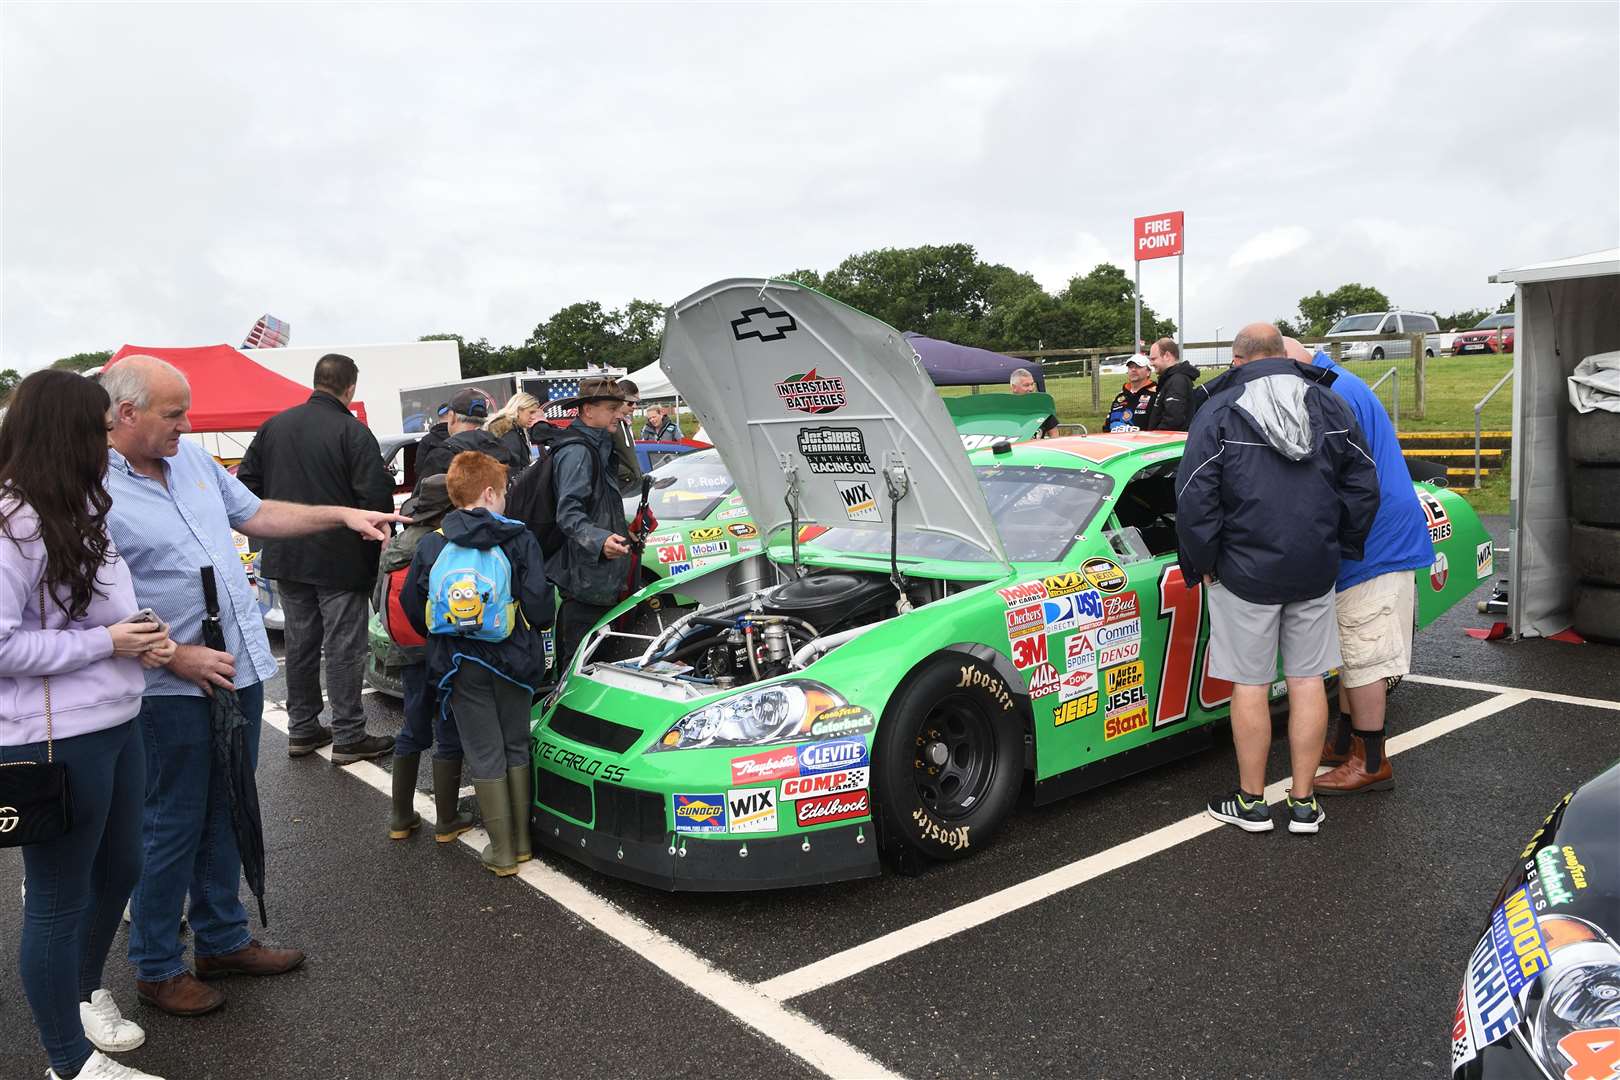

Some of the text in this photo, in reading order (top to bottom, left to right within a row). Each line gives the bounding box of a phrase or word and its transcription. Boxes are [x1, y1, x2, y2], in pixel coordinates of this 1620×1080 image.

[1144, 219, 1171, 234] FIRE
[1139, 233, 1176, 250] POINT
[777, 379, 843, 396] INTERSTATE
[786, 393, 846, 409] BATTERIES
[801, 443, 862, 452] PERFORMANCE
[807, 455, 870, 463] SYNTHETIC
[810, 462, 875, 474] RACING OIL
[841, 483, 872, 506] WIX
[658, 543, 687, 563] 3M
[692, 543, 717, 554] Mobil
[1477, 542, 1492, 567] WIX
[999, 581, 1048, 599] Holley
[1019, 595, 1041, 604] CARBS
[1075, 590, 1103, 619] USG
[1104, 594, 1136, 616] Bud
[1008, 607, 1042, 627] Checkers
[1046, 620, 1075, 633] DIRECTV
[1097, 620, 1139, 645] Commit
[1013, 633, 1048, 669] 3M
[1068, 633, 1094, 658] EA
[1101, 643, 1139, 665] DENSO
[1067, 652, 1095, 669] SPORTS
[1117, 665, 1137, 677] Auto
[956, 664, 1014, 711] Hoosier
[1029, 663, 1058, 691] MAC
[1069, 674, 1088, 685] DOW
[1115, 673, 1142, 689] Meter
[1029, 682, 1060, 700] TOOLS
[1105, 686, 1146, 712] JESEL
[1055, 691, 1098, 727] JEGS
[1105, 707, 1148, 739] Stant
[554, 749, 602, 776] CARLO
[601, 764, 630, 782] SS
[802, 743, 861, 766] CLEVITE
[784, 773, 847, 795] COMP
[828, 782, 859, 792] CAMS
[680, 807, 720, 816] SUNOCO
[730, 790, 773, 818] WIX
[799, 796, 868, 821] Edelbrock
[912, 807, 970, 851] Hoosier
[1525, 860, 1547, 911] BELTS
[1504, 888, 1549, 978] MOOG
[1501, 950, 1524, 989] PARTS
[1472, 931, 1518, 1043] MAHLE
